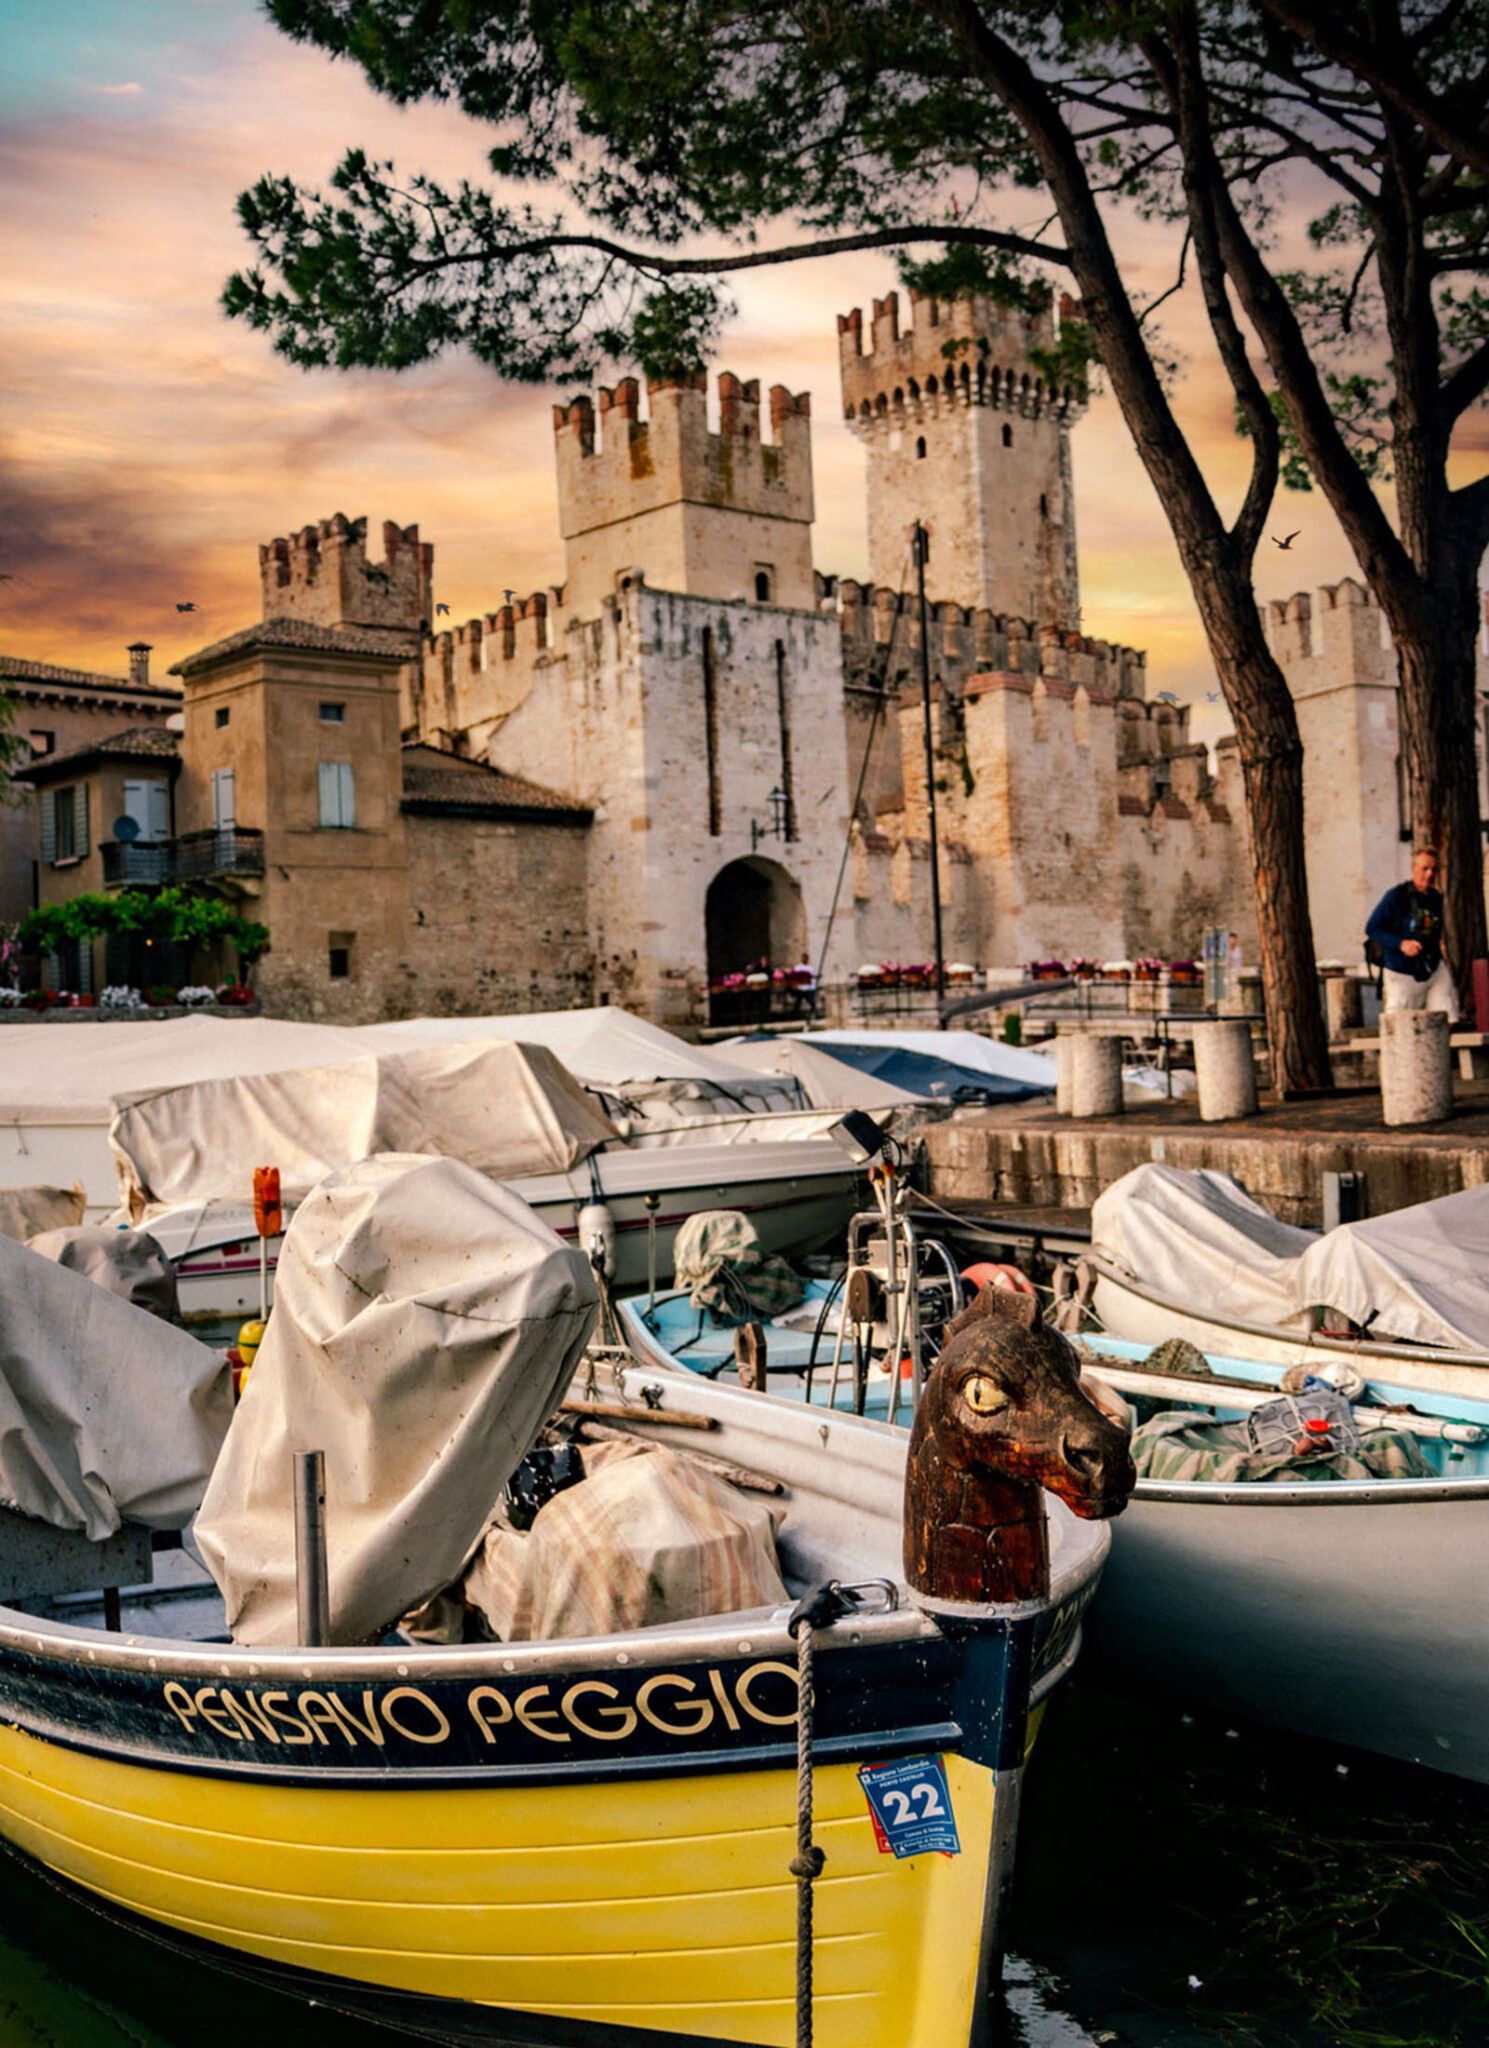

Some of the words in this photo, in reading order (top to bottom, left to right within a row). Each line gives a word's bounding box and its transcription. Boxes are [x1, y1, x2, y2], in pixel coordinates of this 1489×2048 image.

[163, 1681, 450, 1746] PENSAVO
[467, 1661, 815, 1744] PEGGIO
[882, 1783, 946, 1827] 22
